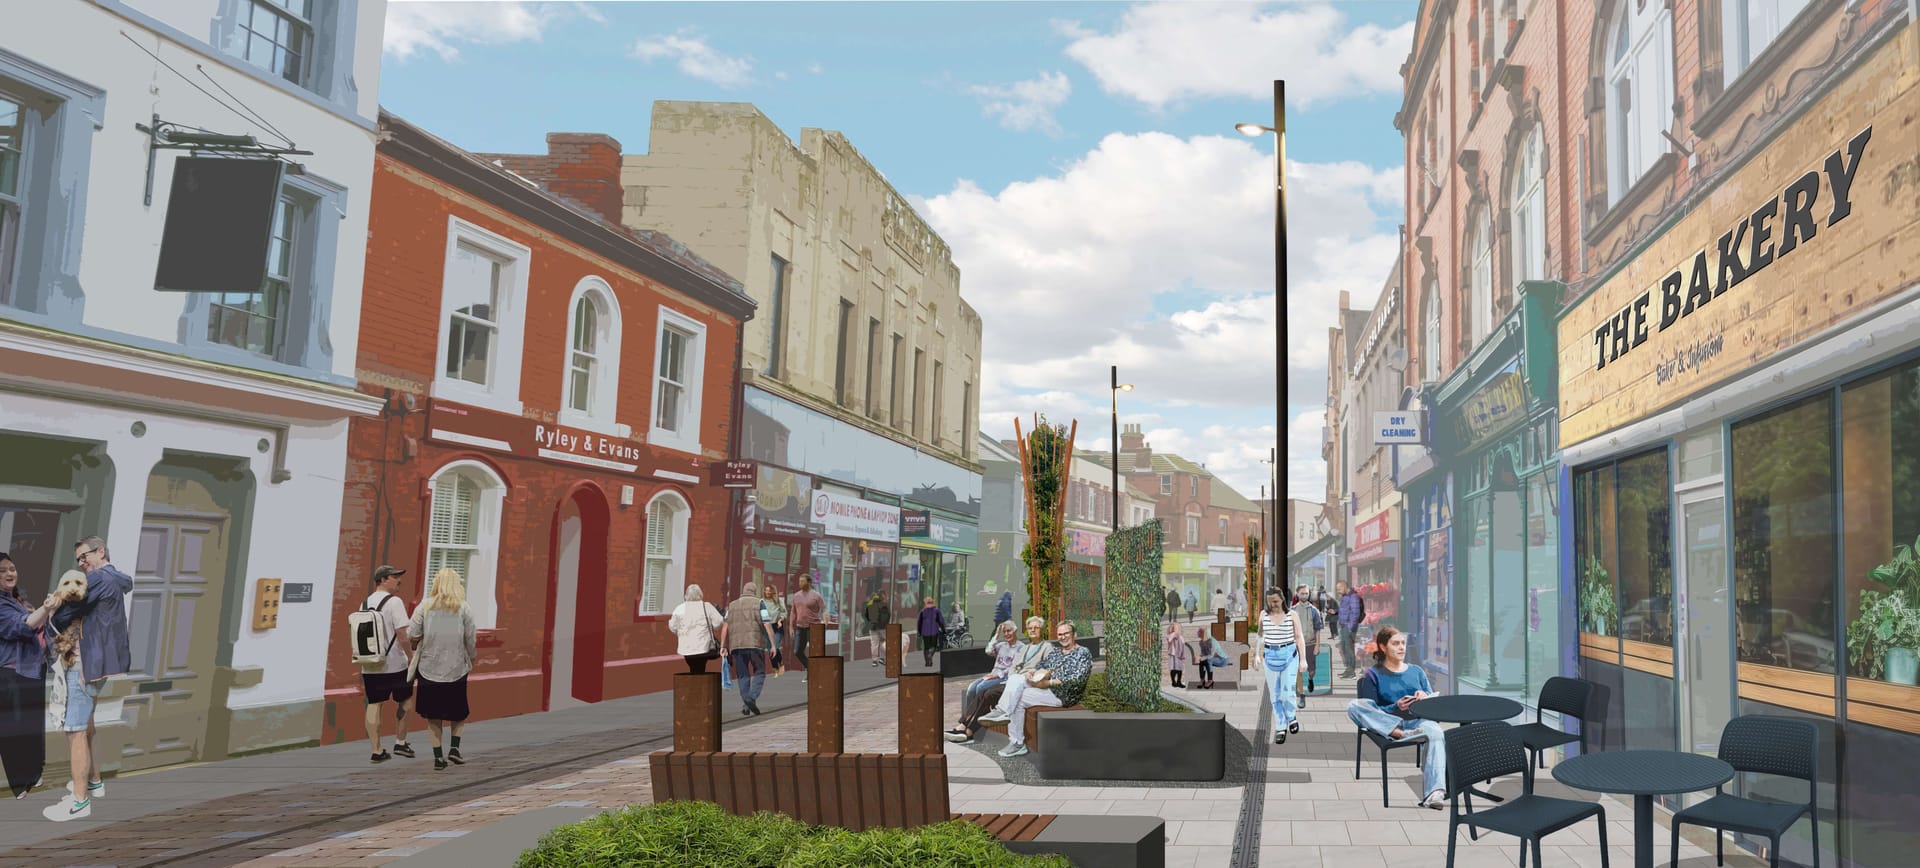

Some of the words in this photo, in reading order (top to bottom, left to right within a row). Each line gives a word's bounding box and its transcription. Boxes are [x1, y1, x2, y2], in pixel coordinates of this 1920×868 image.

[1594, 290, 1650, 371] THE
[1658, 124, 1873, 333] BAKERY
[1678, 349, 1686, 374] &
[1381, 428, 1416, 437] CLEANING
[1390, 416, 1406, 425] DRY
[535, 424, 578, 452] Ryley
[583, 435, 593, 451] &
[598, 437, 640, 460] Evans
[727, 461, 752, 469] Ryley
[831, 501, 850, 517] MOBILE
[850, 505, 867, 519] PHONE
[871, 509, 888, 523] LAPTOP
[887, 511, 899, 525] ZONE
